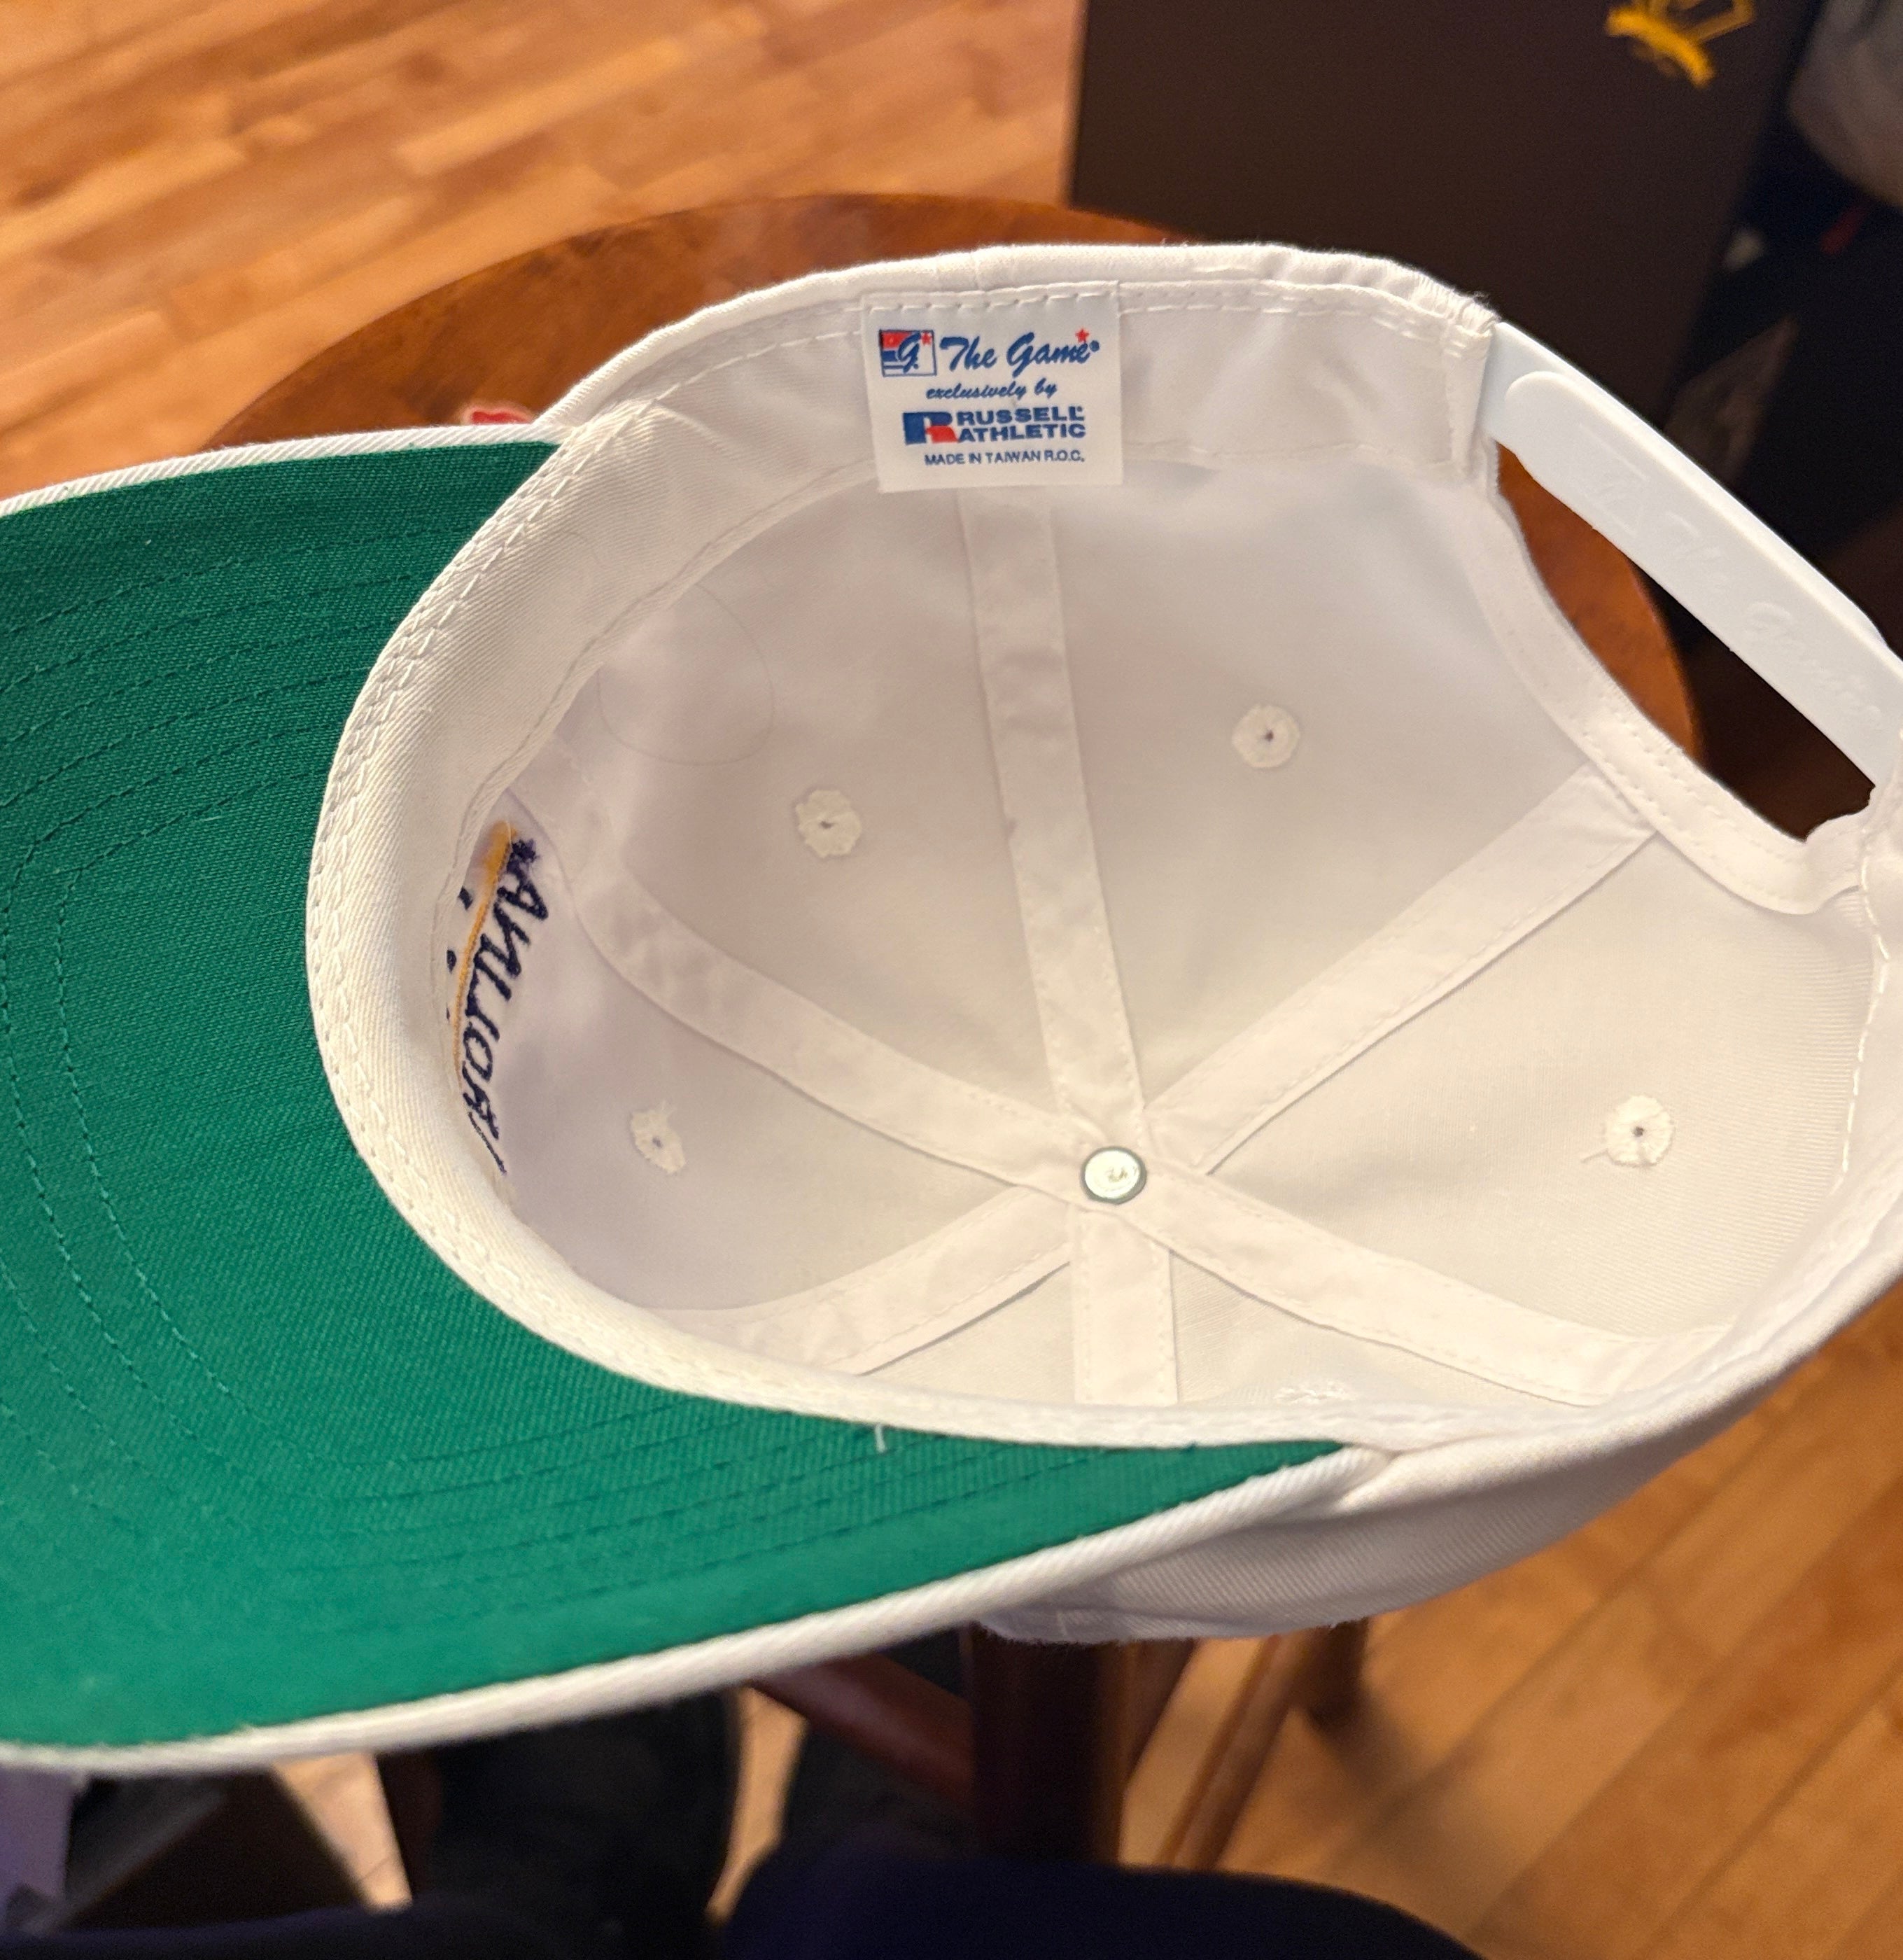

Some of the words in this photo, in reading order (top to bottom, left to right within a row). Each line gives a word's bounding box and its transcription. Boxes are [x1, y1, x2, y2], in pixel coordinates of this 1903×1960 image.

[939, 335, 998, 372] The
[926, 383, 1026, 400] exclusively
[1034, 378, 1057, 396] by
[957, 406, 1085, 426] RUSSELL
[959, 424, 1086, 443] ATHLETIC
[925, 454, 964, 465] MADE
[969, 453, 981, 463] IN
[986, 450, 1041, 463] TAIWAN
[1044, 450, 1085, 462] R.O.C.
